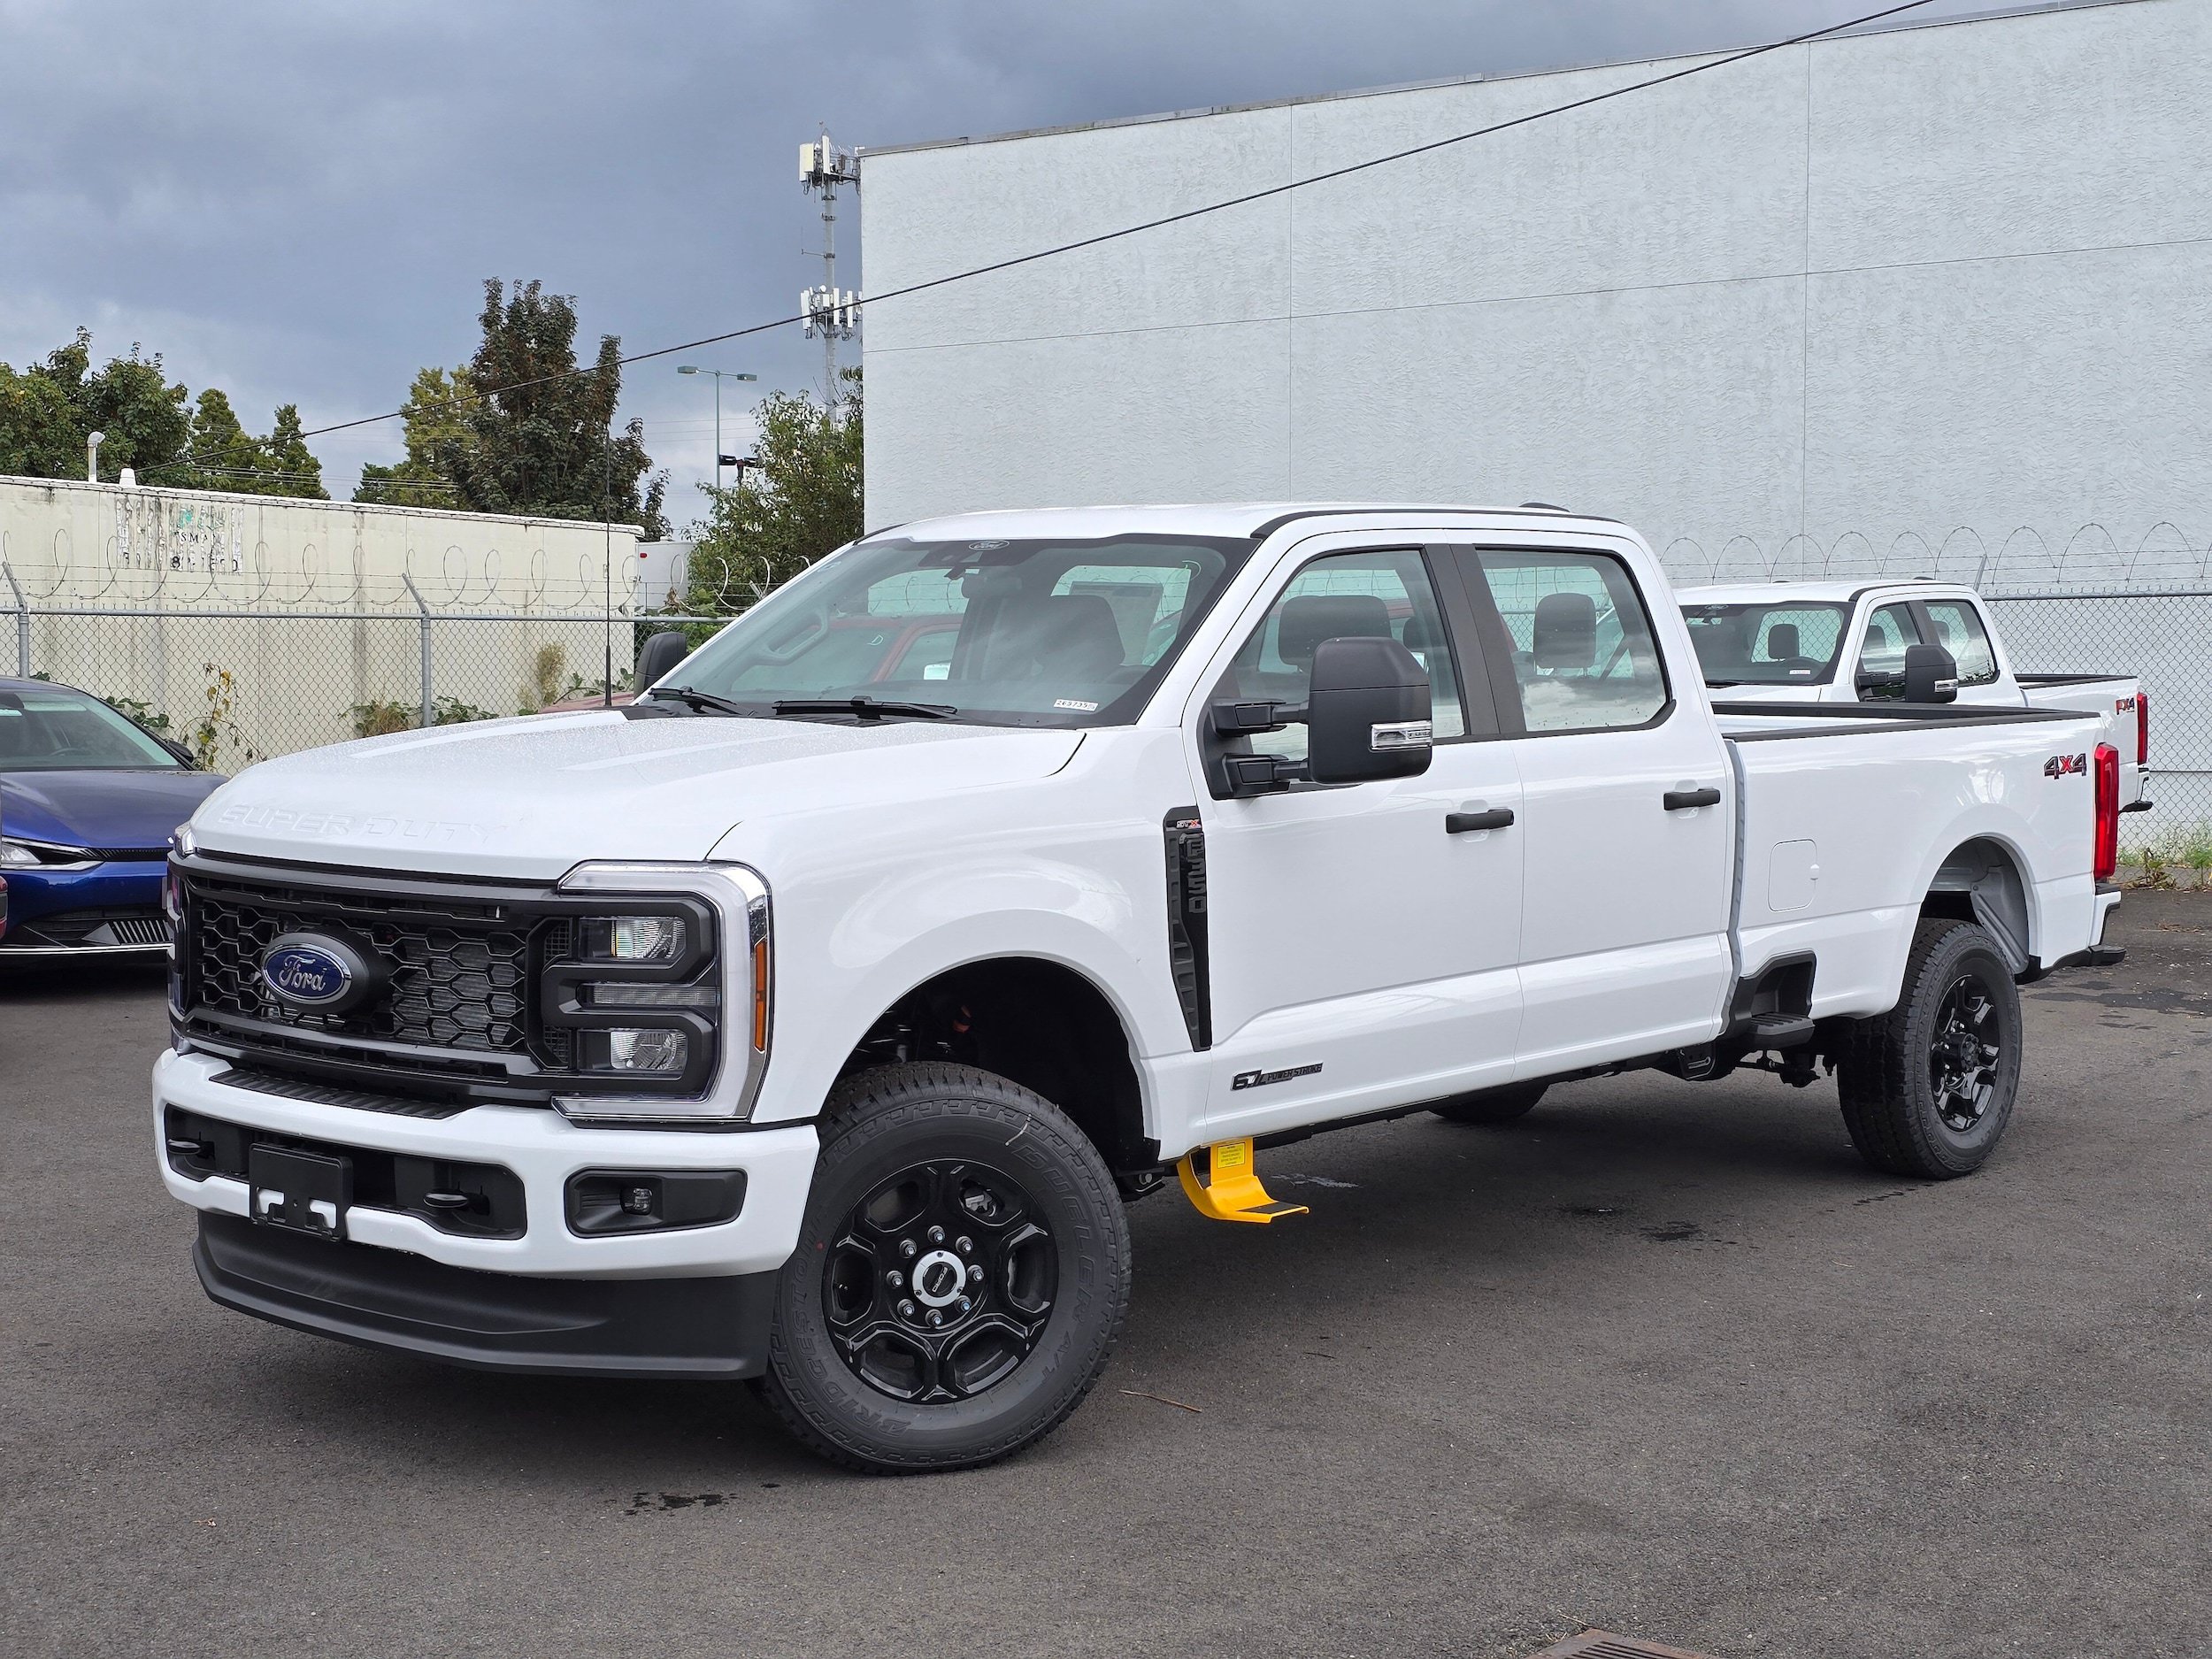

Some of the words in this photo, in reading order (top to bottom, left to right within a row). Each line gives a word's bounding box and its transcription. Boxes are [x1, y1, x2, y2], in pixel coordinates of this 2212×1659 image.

[219, 804, 356, 834] SUPER
[362, 816, 508, 843] DUTY
[279, 955, 326, 992] Ford
[1011, 1142, 1096, 1325] DUELER
[932, 1266, 949, 1293] FORD
